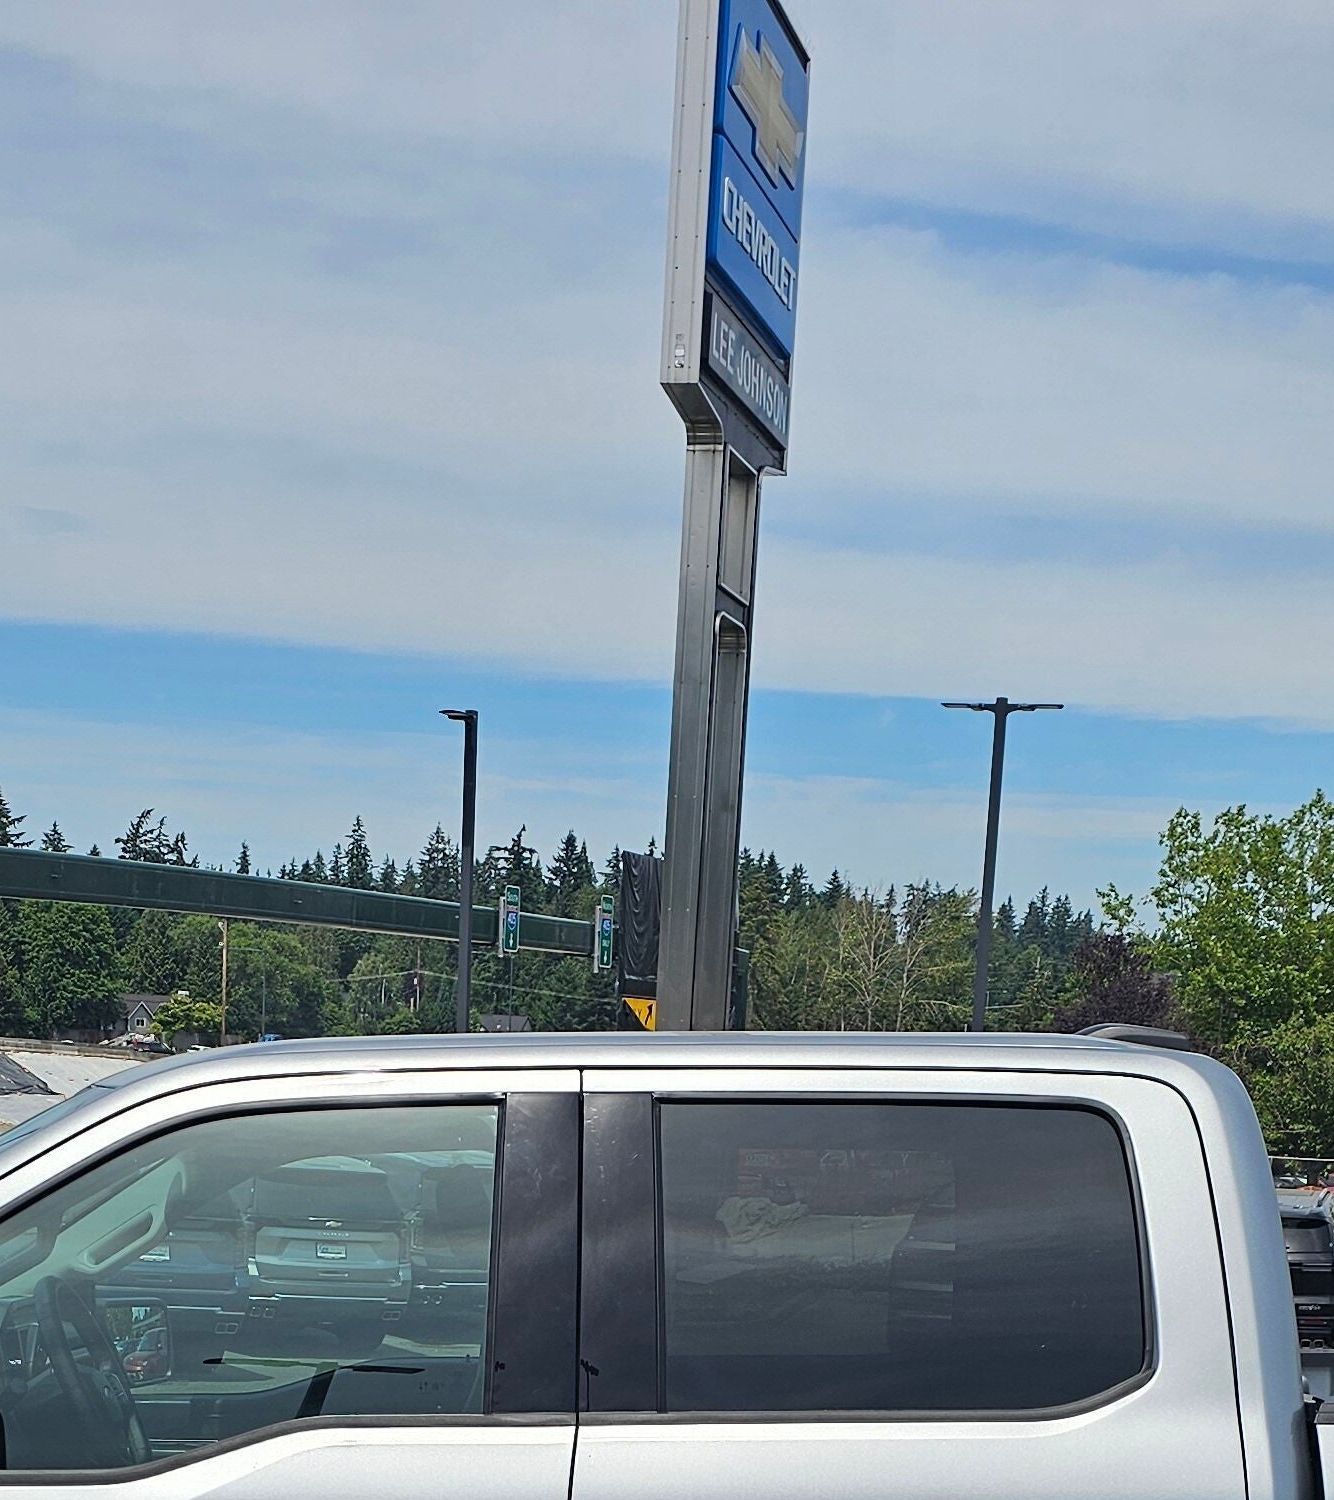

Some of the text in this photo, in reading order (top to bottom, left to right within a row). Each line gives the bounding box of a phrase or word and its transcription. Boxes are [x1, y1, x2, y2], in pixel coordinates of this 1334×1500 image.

[723, 176, 796, 310] CHEVROLET
[712, 312, 788, 434] LEE JOHNSON
